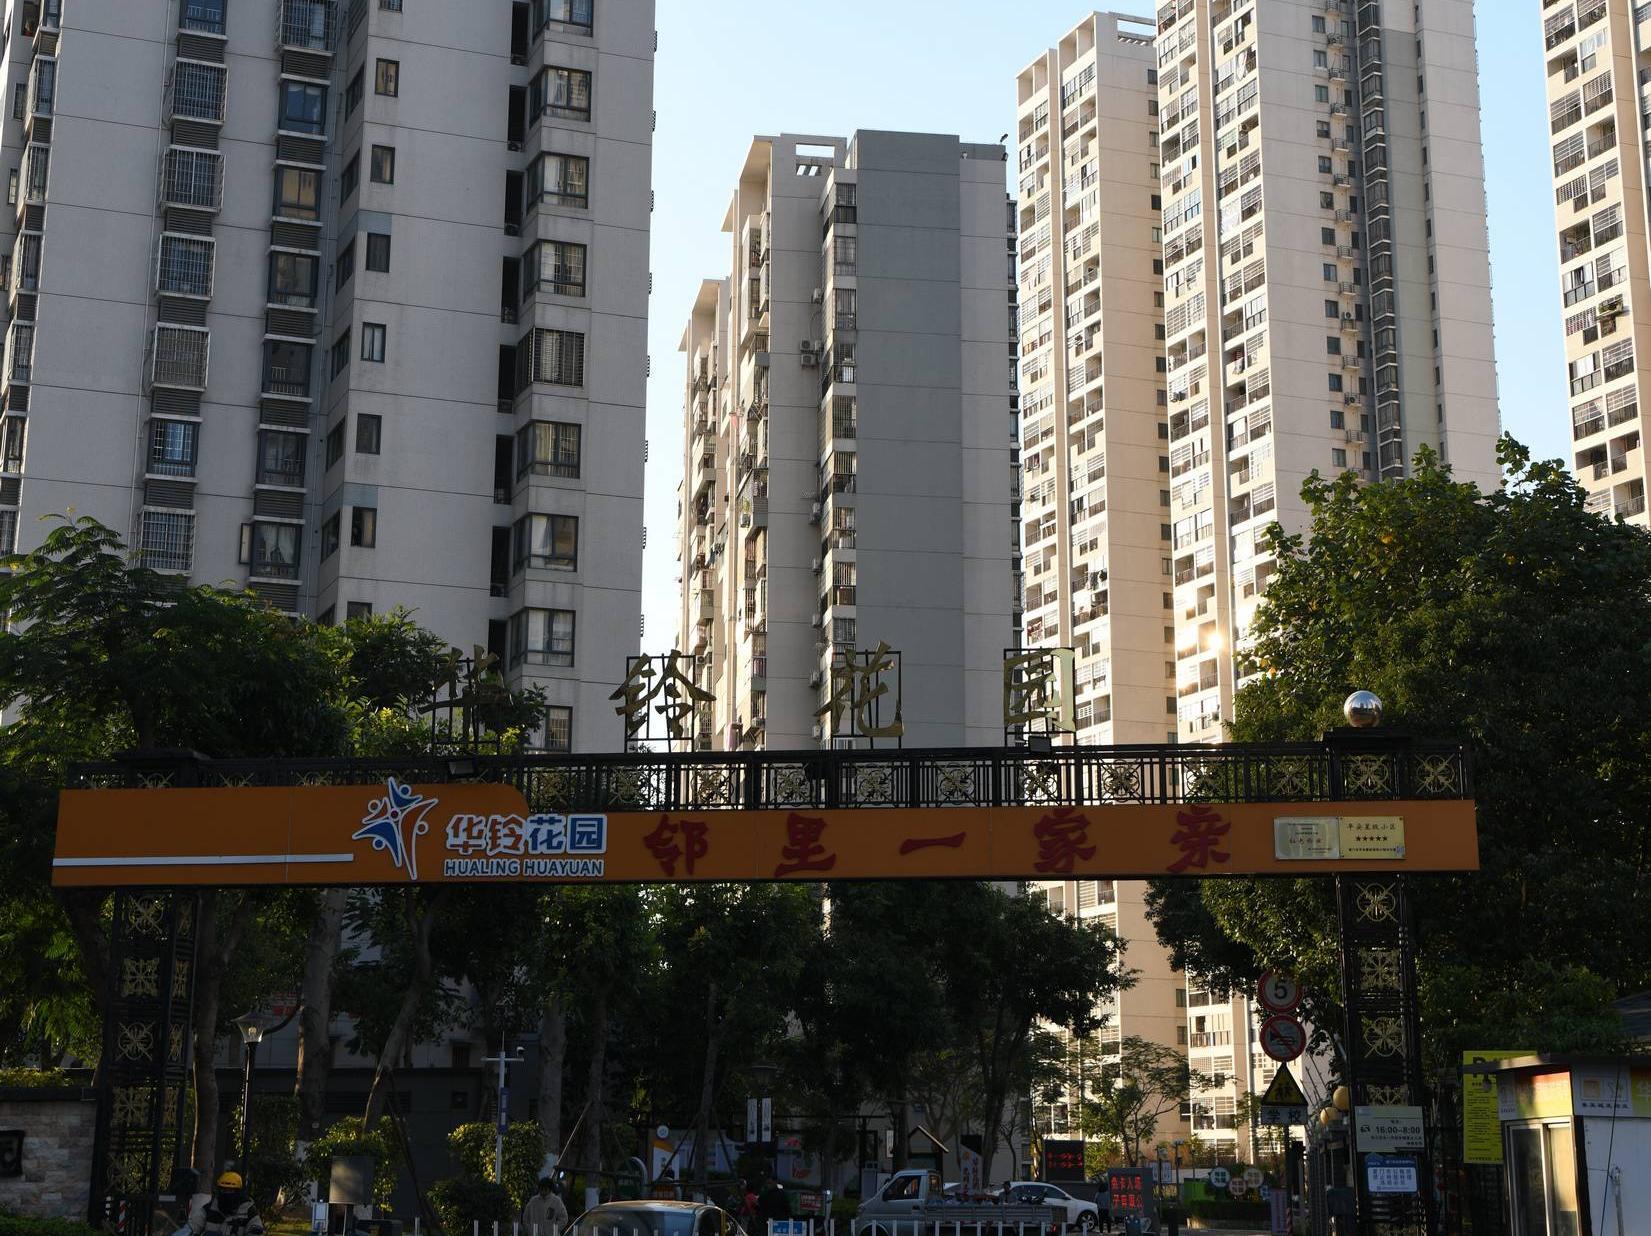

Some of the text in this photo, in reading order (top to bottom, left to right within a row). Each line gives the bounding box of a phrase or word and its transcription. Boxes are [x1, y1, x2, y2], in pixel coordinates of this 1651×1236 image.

[446, 813, 608, 856] 华铃花园
[643, 805, 1231, 878] 邻里一家亲
[444, 858, 604, 877] HUALING HUAYUAN
[1274, 979, 1287, 999] 5
[1266, 1109, 1301, 1123] 学校
